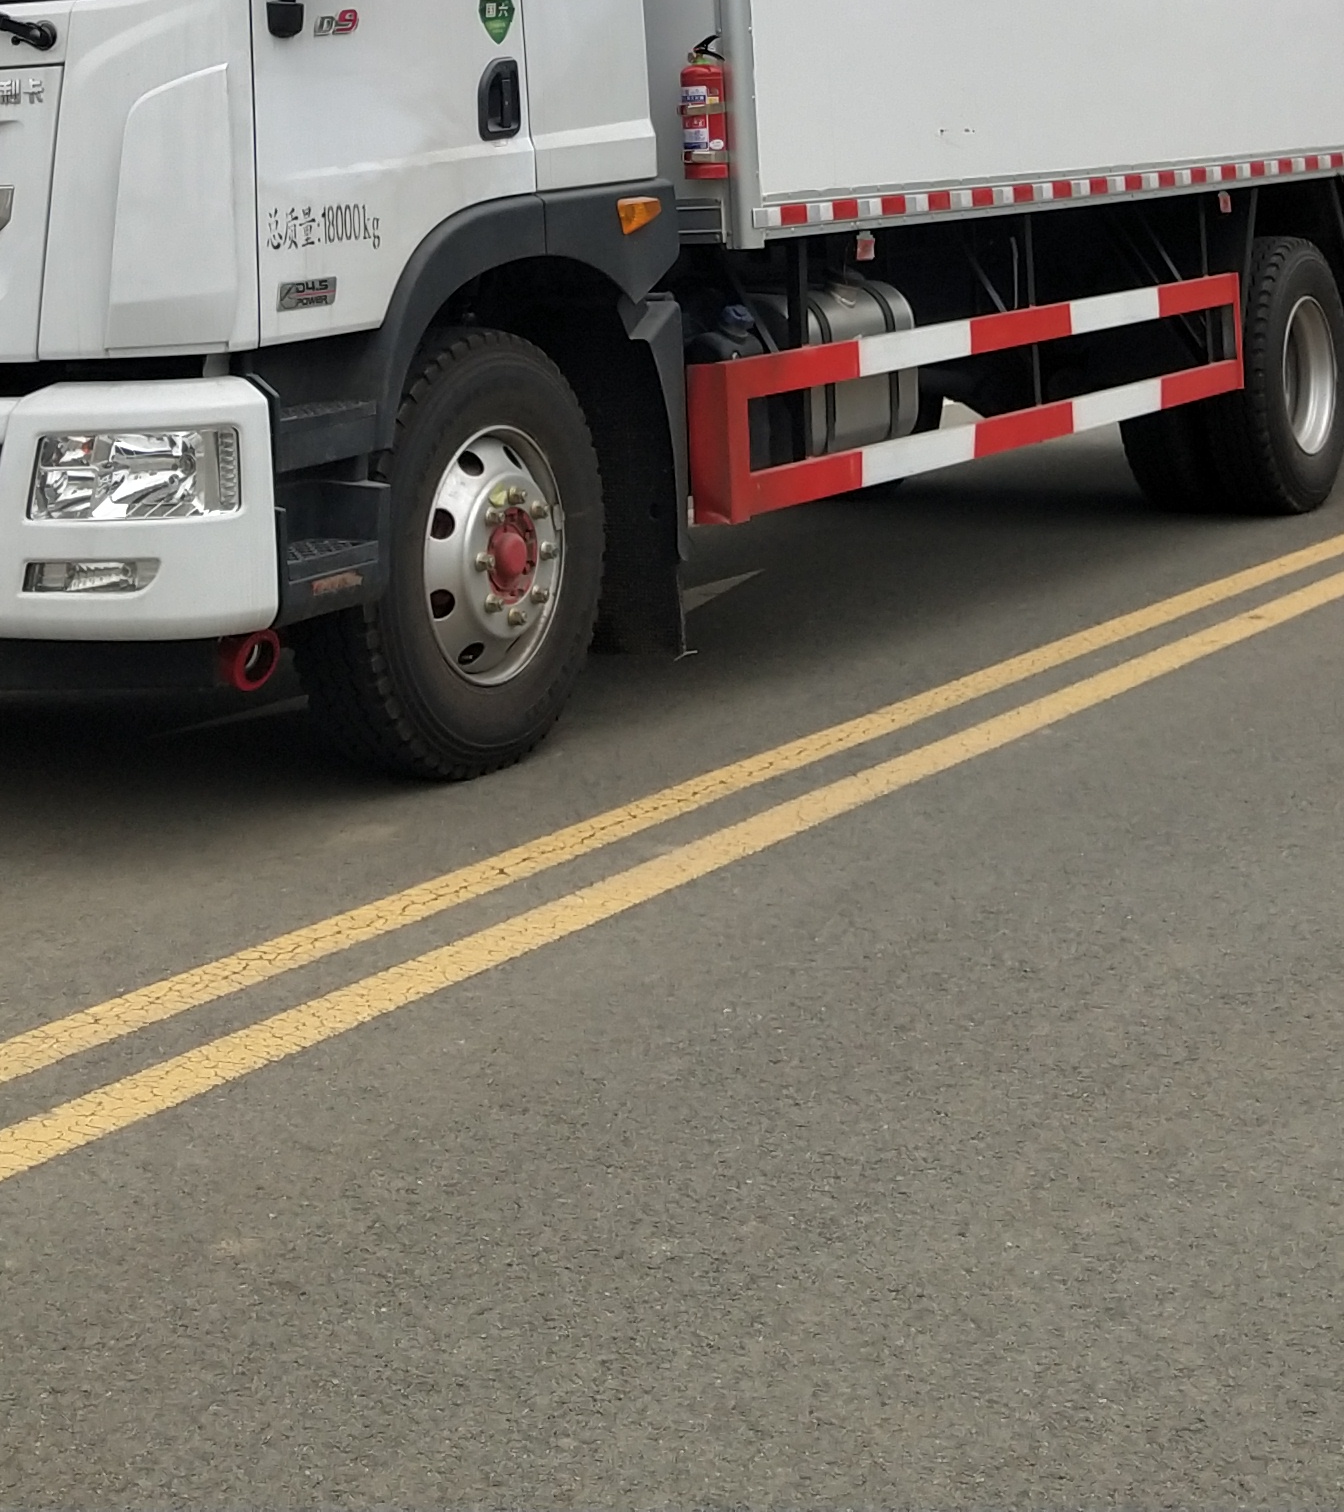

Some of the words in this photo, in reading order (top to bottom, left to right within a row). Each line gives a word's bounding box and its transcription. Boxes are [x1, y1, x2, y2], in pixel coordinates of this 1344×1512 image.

[485, 2, 509, 18] 国六
[314, 9, 359, 37] D9
[296, 295, 328, 307] POWER
